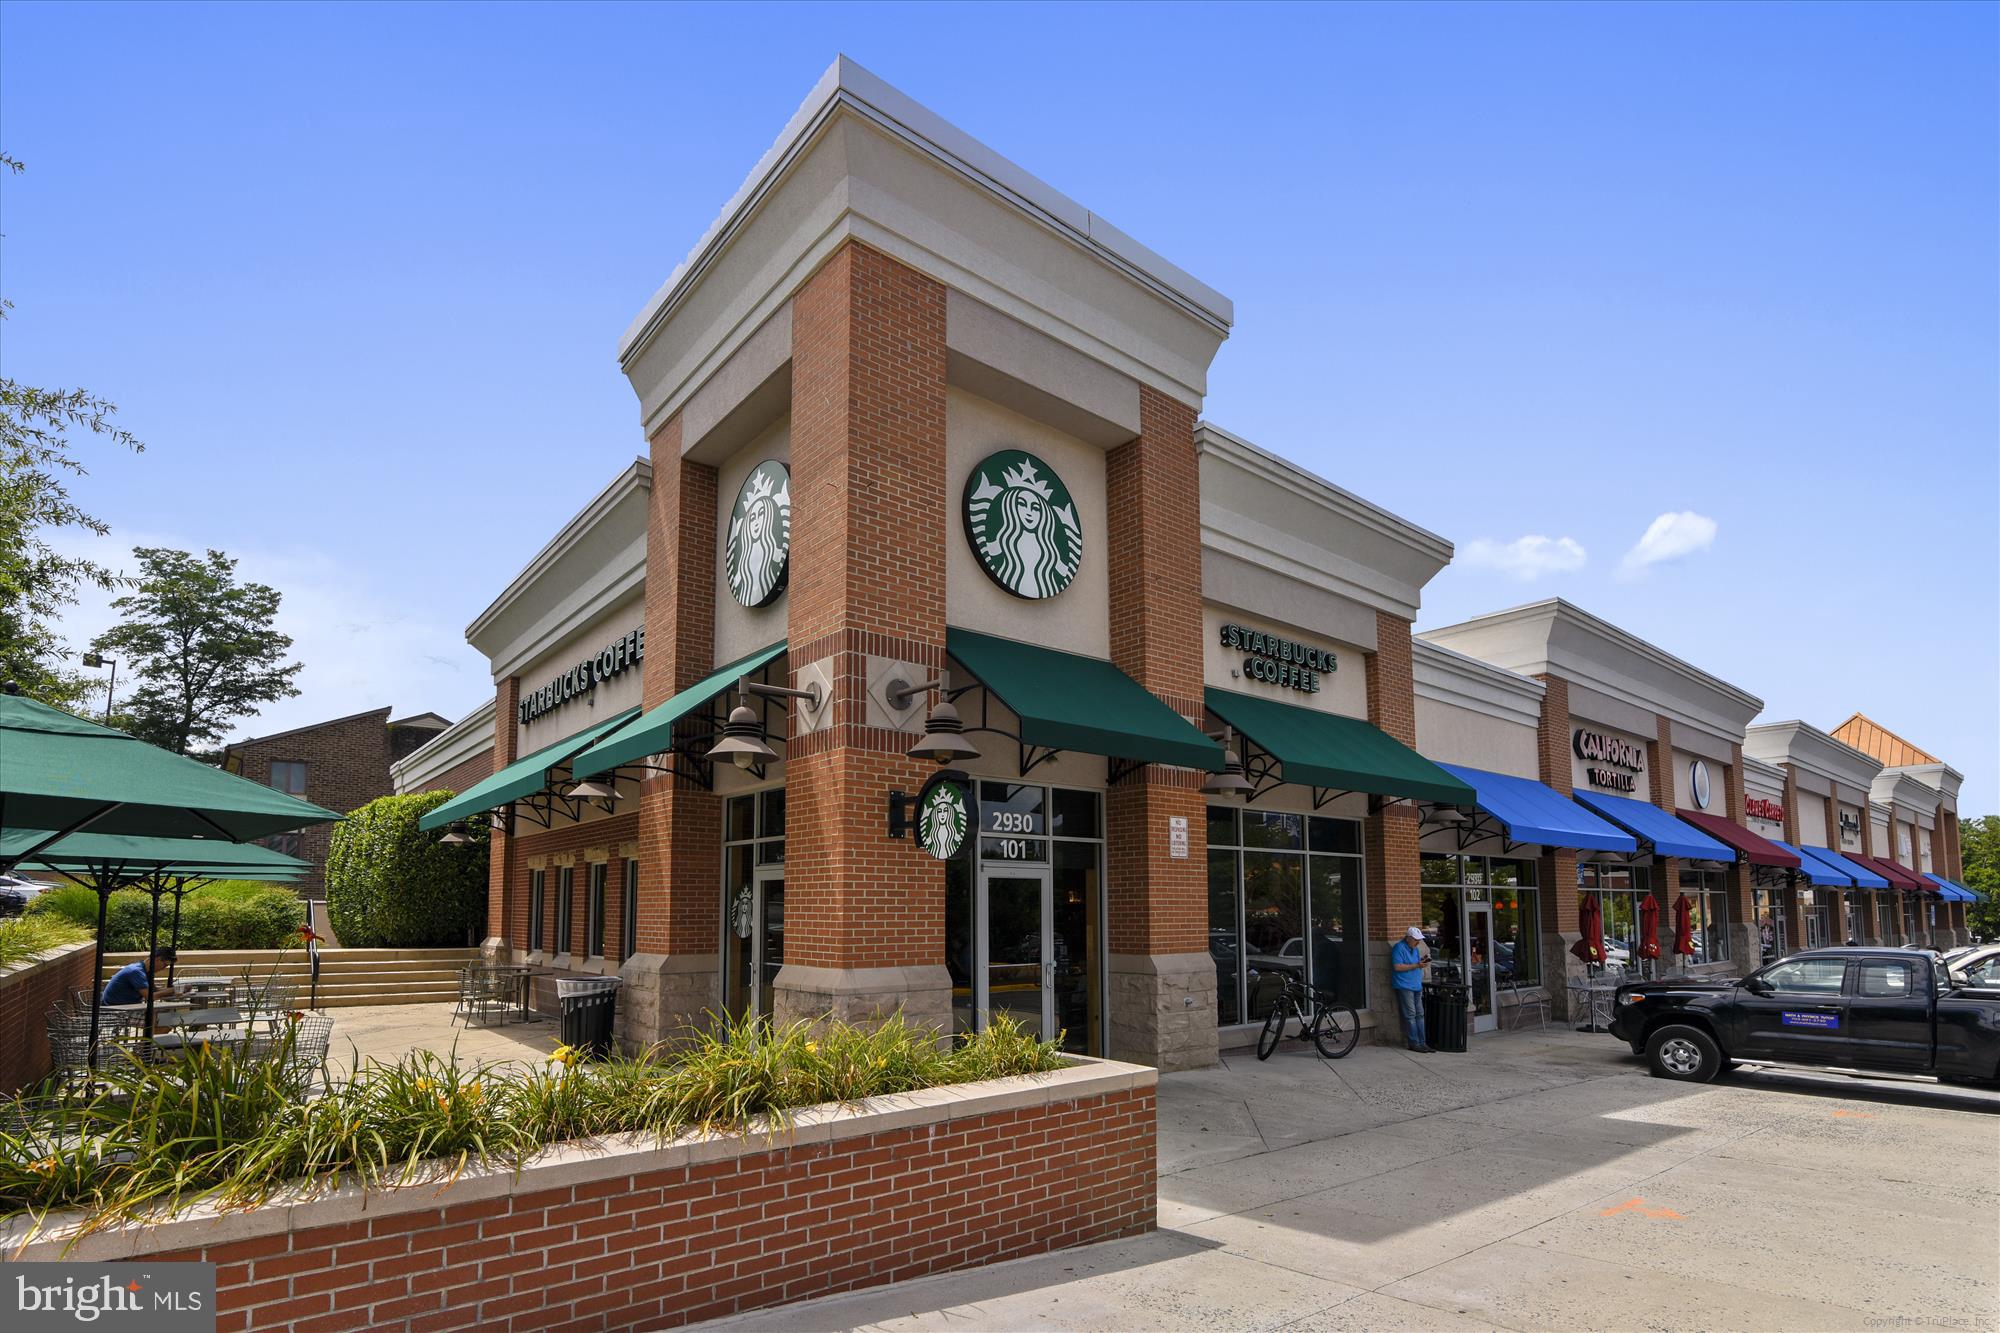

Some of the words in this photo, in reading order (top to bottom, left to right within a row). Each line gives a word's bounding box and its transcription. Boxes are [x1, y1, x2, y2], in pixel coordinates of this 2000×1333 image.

[1223, 623, 1338, 673] STARBUCKS
[518, 660, 591, 724] STARBUCKS
[593, 625, 645, 682] COFFE
[1248, 655, 1320, 693] COFFEE
[1575, 729, 1645, 772] CALIFORNIA
[1590, 768, 1636, 792] TORTILLA
[992, 811, 1033, 833] 2930
[1000, 839, 1026, 859] 101
[1470, 889, 1480, 900] 102
